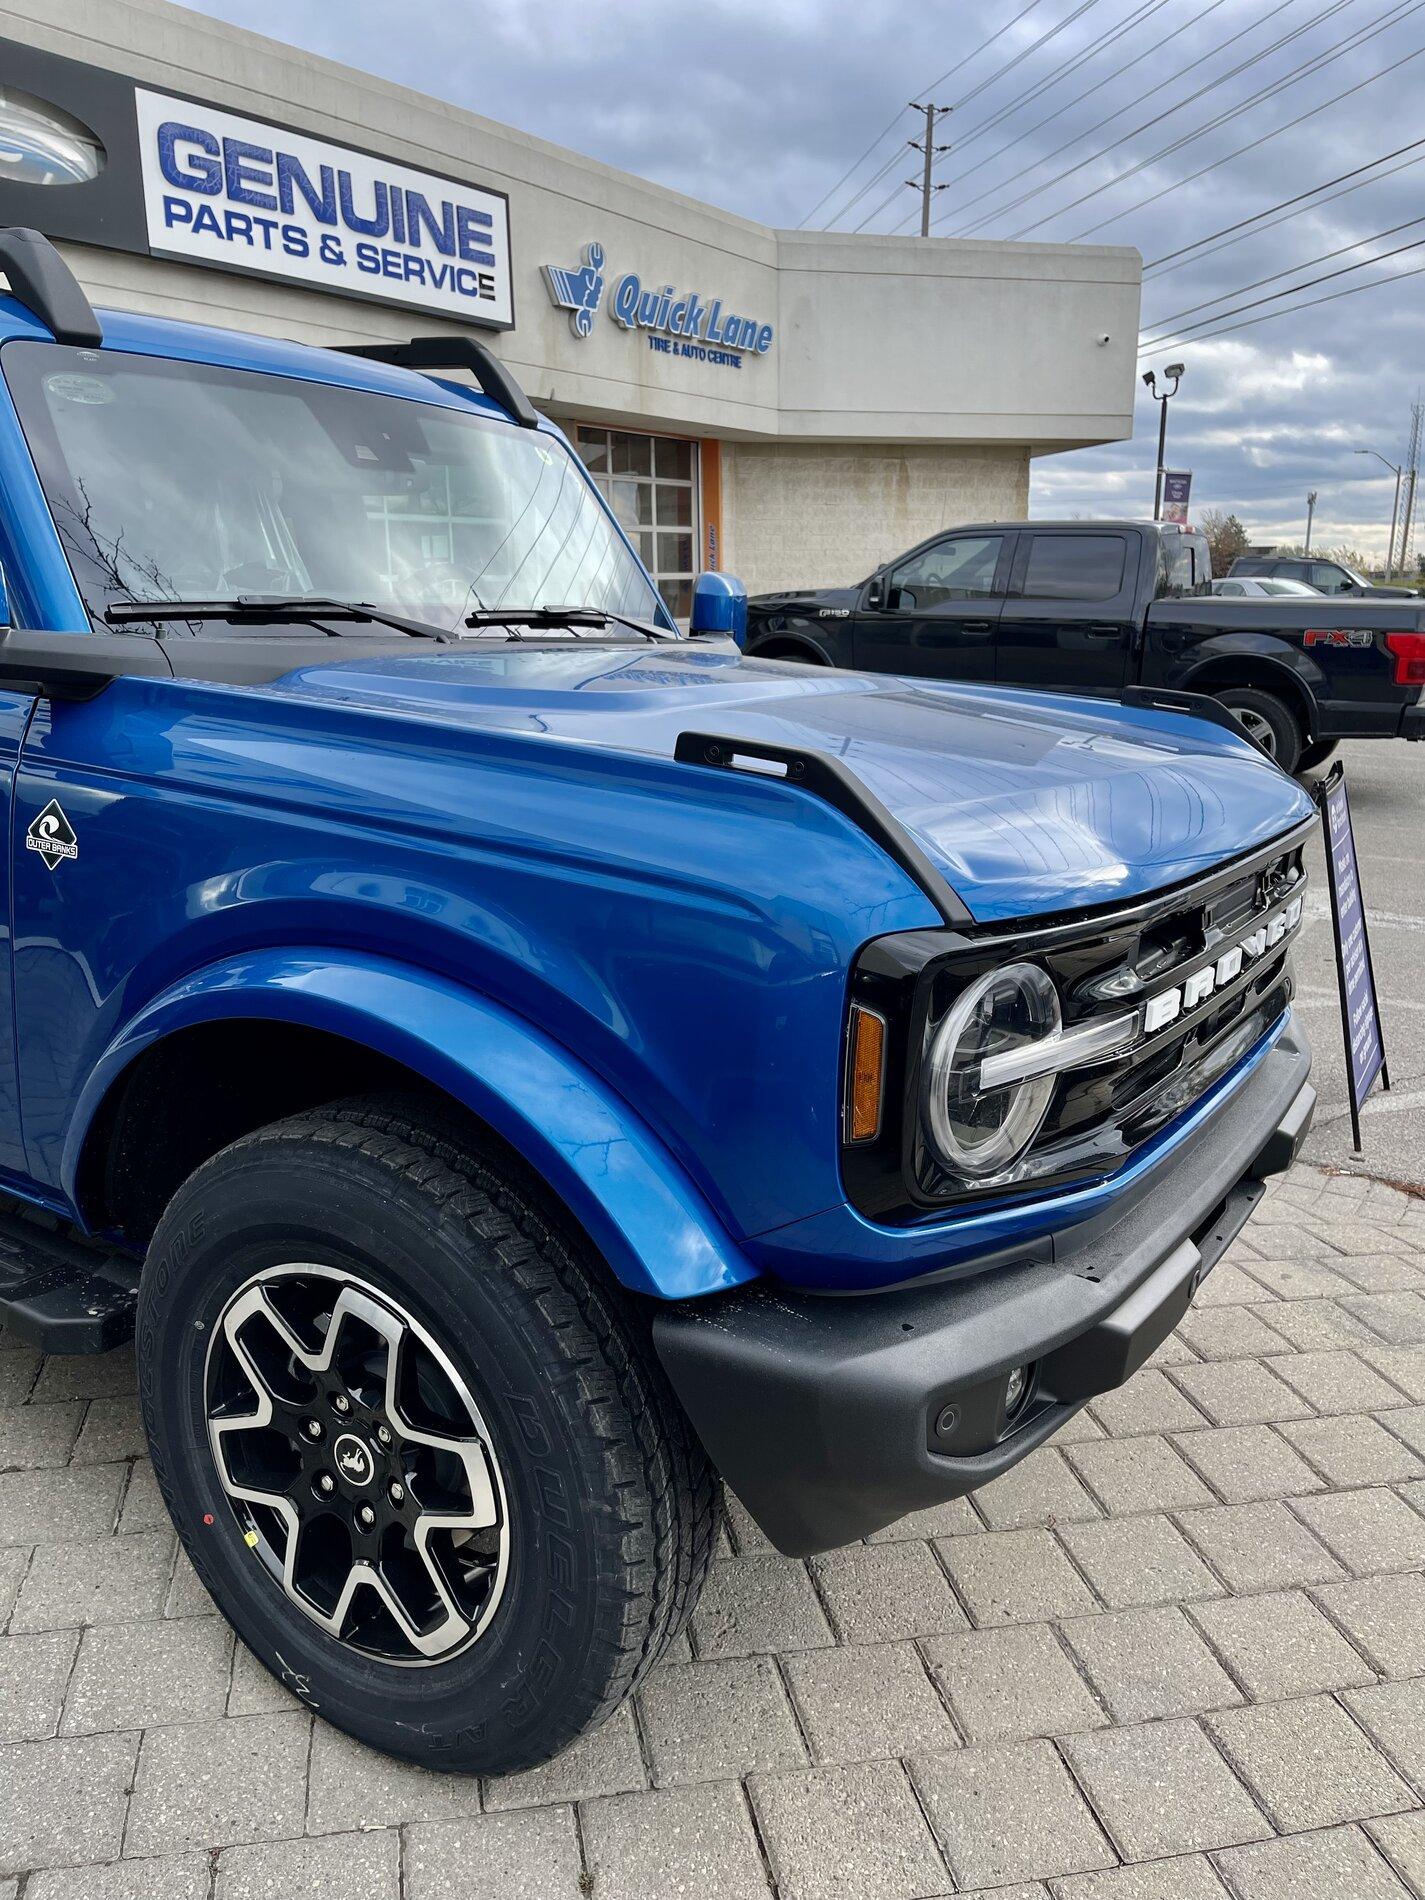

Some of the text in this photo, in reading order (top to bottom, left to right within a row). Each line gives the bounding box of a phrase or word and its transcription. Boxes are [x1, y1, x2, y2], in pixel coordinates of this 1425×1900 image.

[157, 121, 496, 267] GENUINE
[162, 195, 496, 302] PARTS & SERVICE
[611, 272, 775, 355] Quick Lane
[648, 335, 743, 369] TIRE & AUTO CENTRE
[1303, 628, 1373, 647] FX4
[28, 838, 76, 856] OUTER BANKS
[1144, 896, 1302, 1033] BRONCO
[501, 1390, 576, 1730] DUELER
